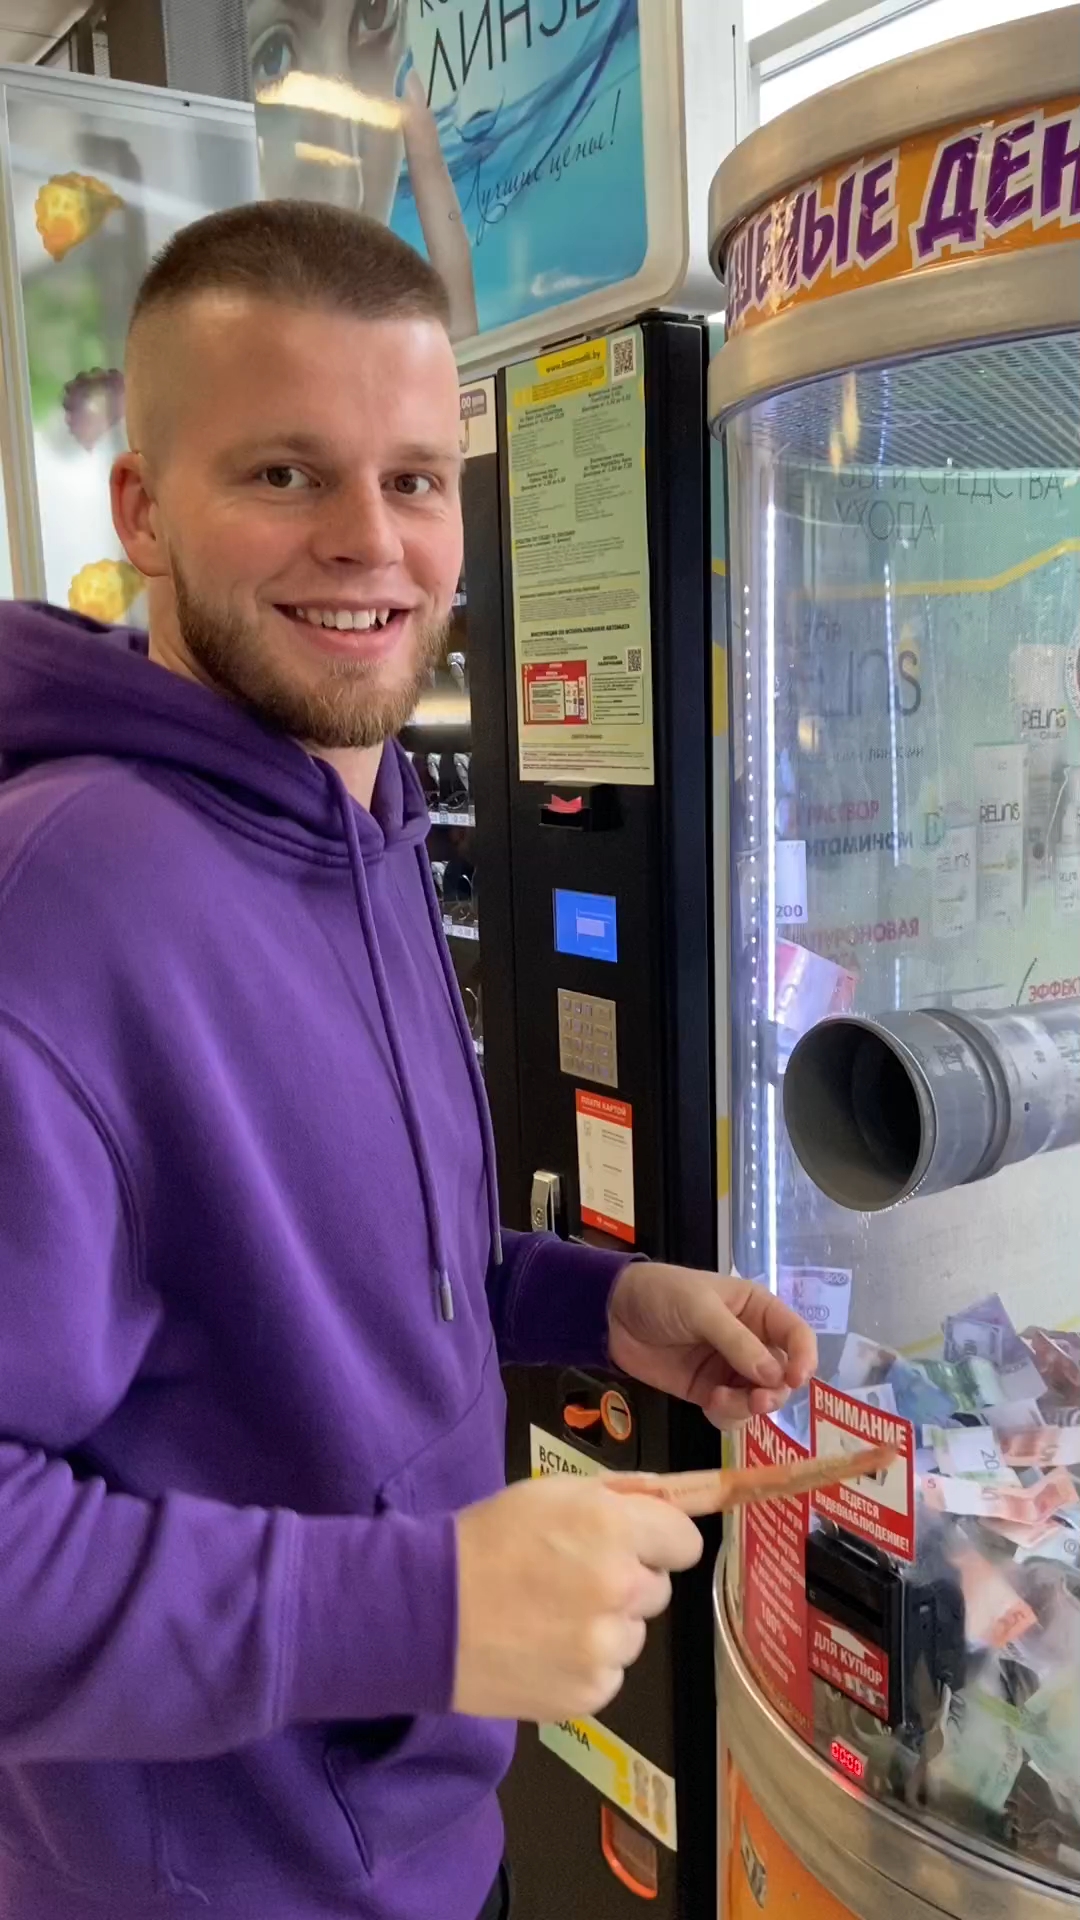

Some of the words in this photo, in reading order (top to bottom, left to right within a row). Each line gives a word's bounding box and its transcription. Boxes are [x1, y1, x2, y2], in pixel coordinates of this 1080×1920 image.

[814, 1385, 908, 1451] ВНИМАНИЕ
[839, 1486, 880, 1520] ВЕДЕТСЯ
[814, 1631, 838, 1658] ДЛЯ
[840, 1647, 883, 1686] КУПЮР
